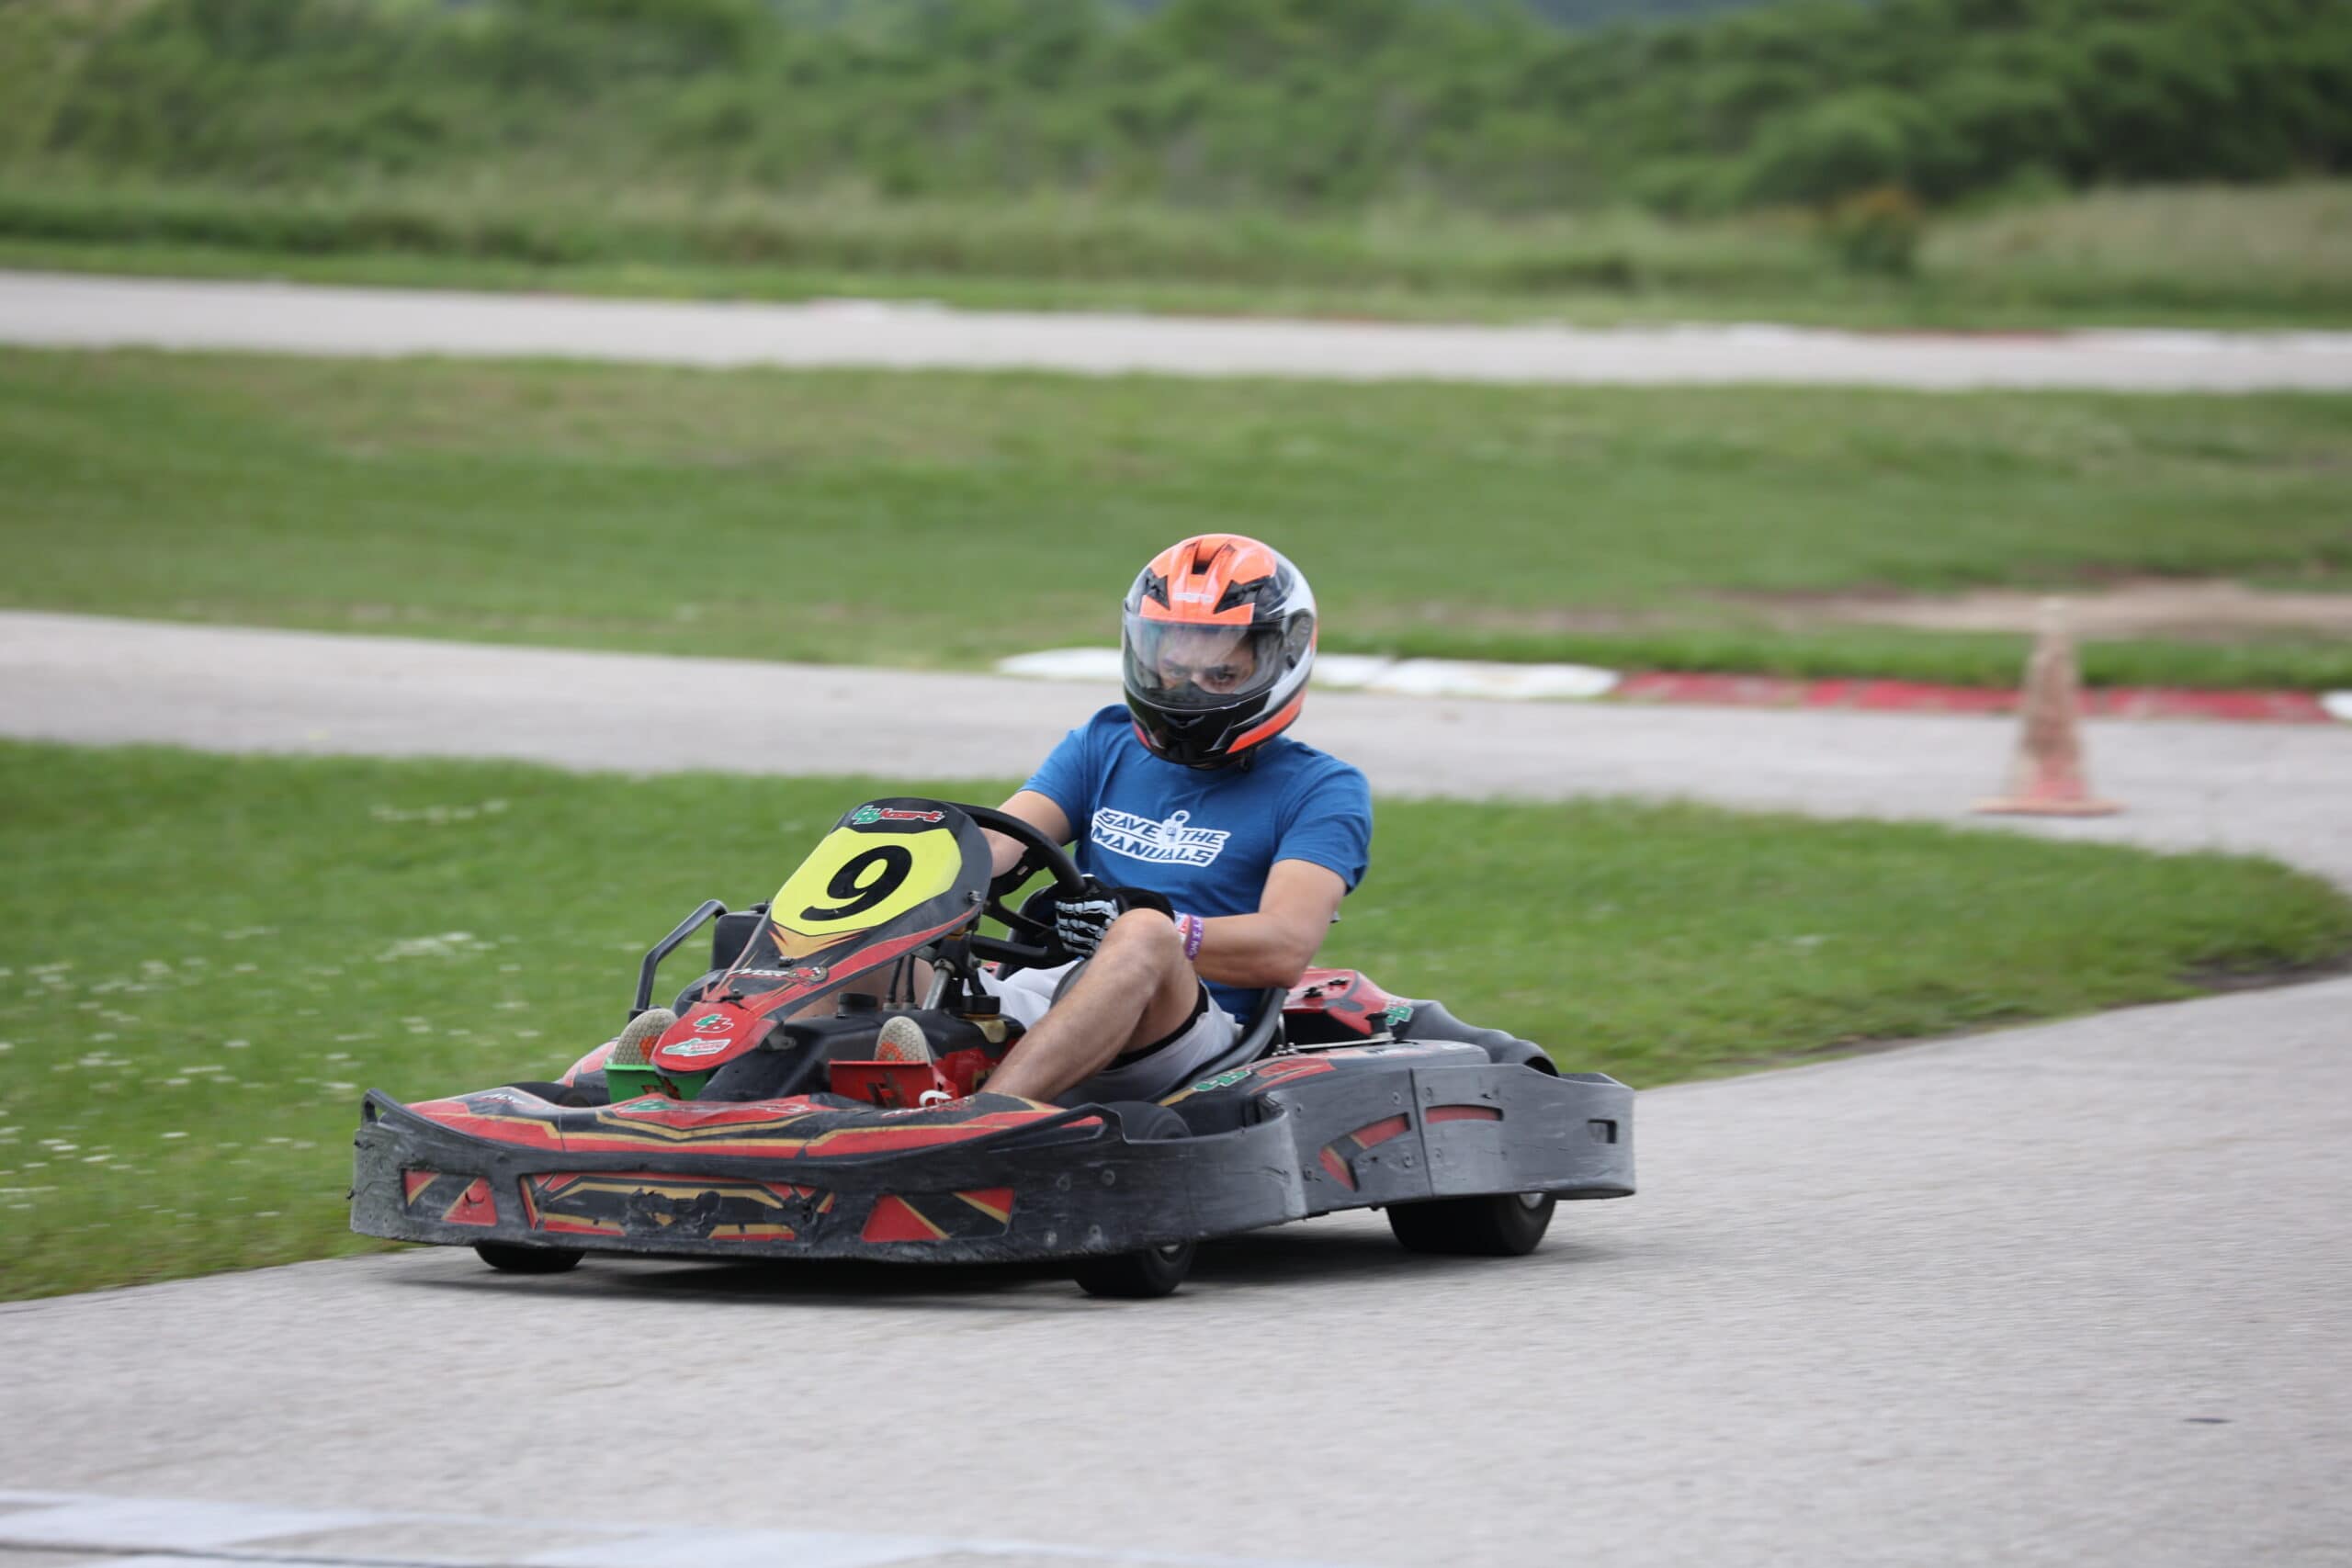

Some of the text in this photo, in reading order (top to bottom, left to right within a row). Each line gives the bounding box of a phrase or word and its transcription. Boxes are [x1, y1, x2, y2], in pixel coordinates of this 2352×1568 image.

[1091, 826, 1215, 863] MANUALS
[1102, 811, 1227, 846] SAVE THE
[799, 844, 912, 921] 9
